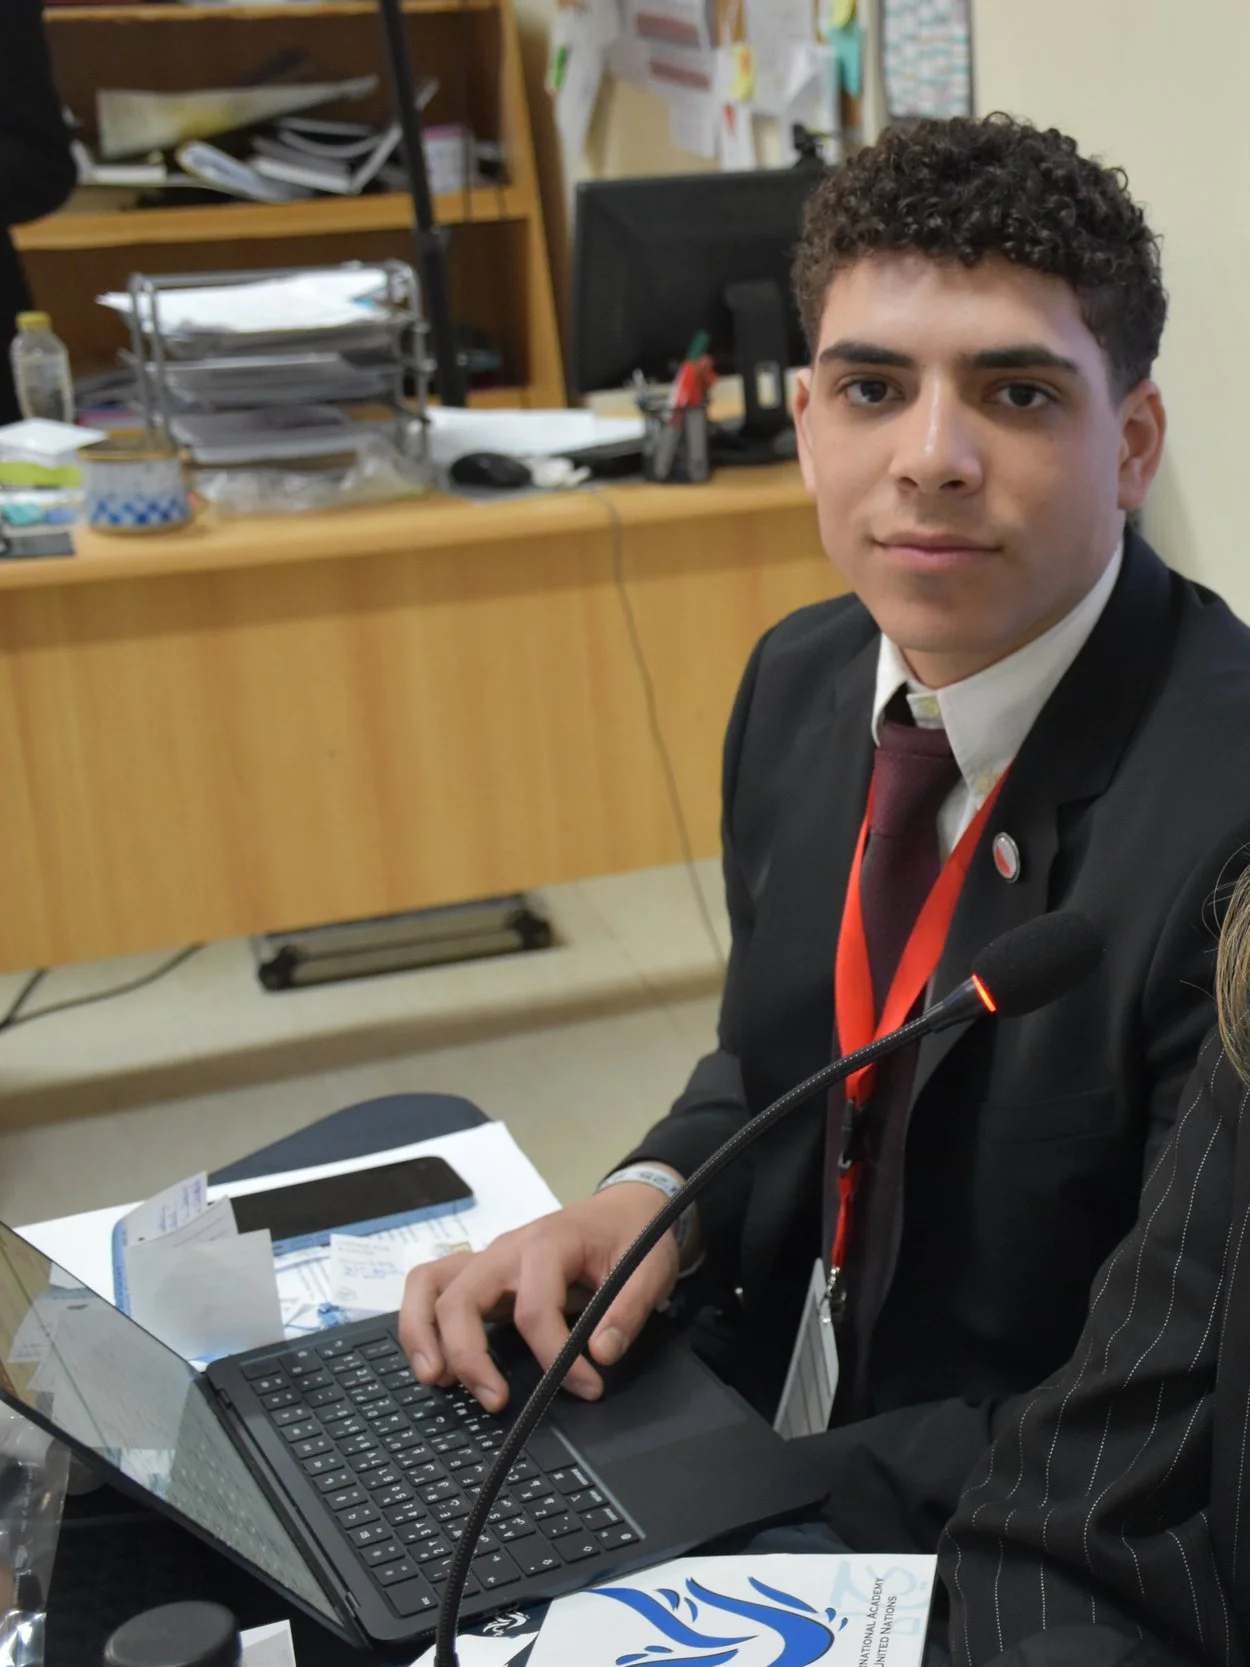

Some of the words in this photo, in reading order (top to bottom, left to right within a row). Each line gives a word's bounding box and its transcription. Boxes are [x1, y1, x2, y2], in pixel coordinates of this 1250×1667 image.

[866, 1577, 885, 1619] ACADEMY
[880, 1596, 897, 1635] NATIONS
[858, 1620, 876, 1667] NATIONAL
